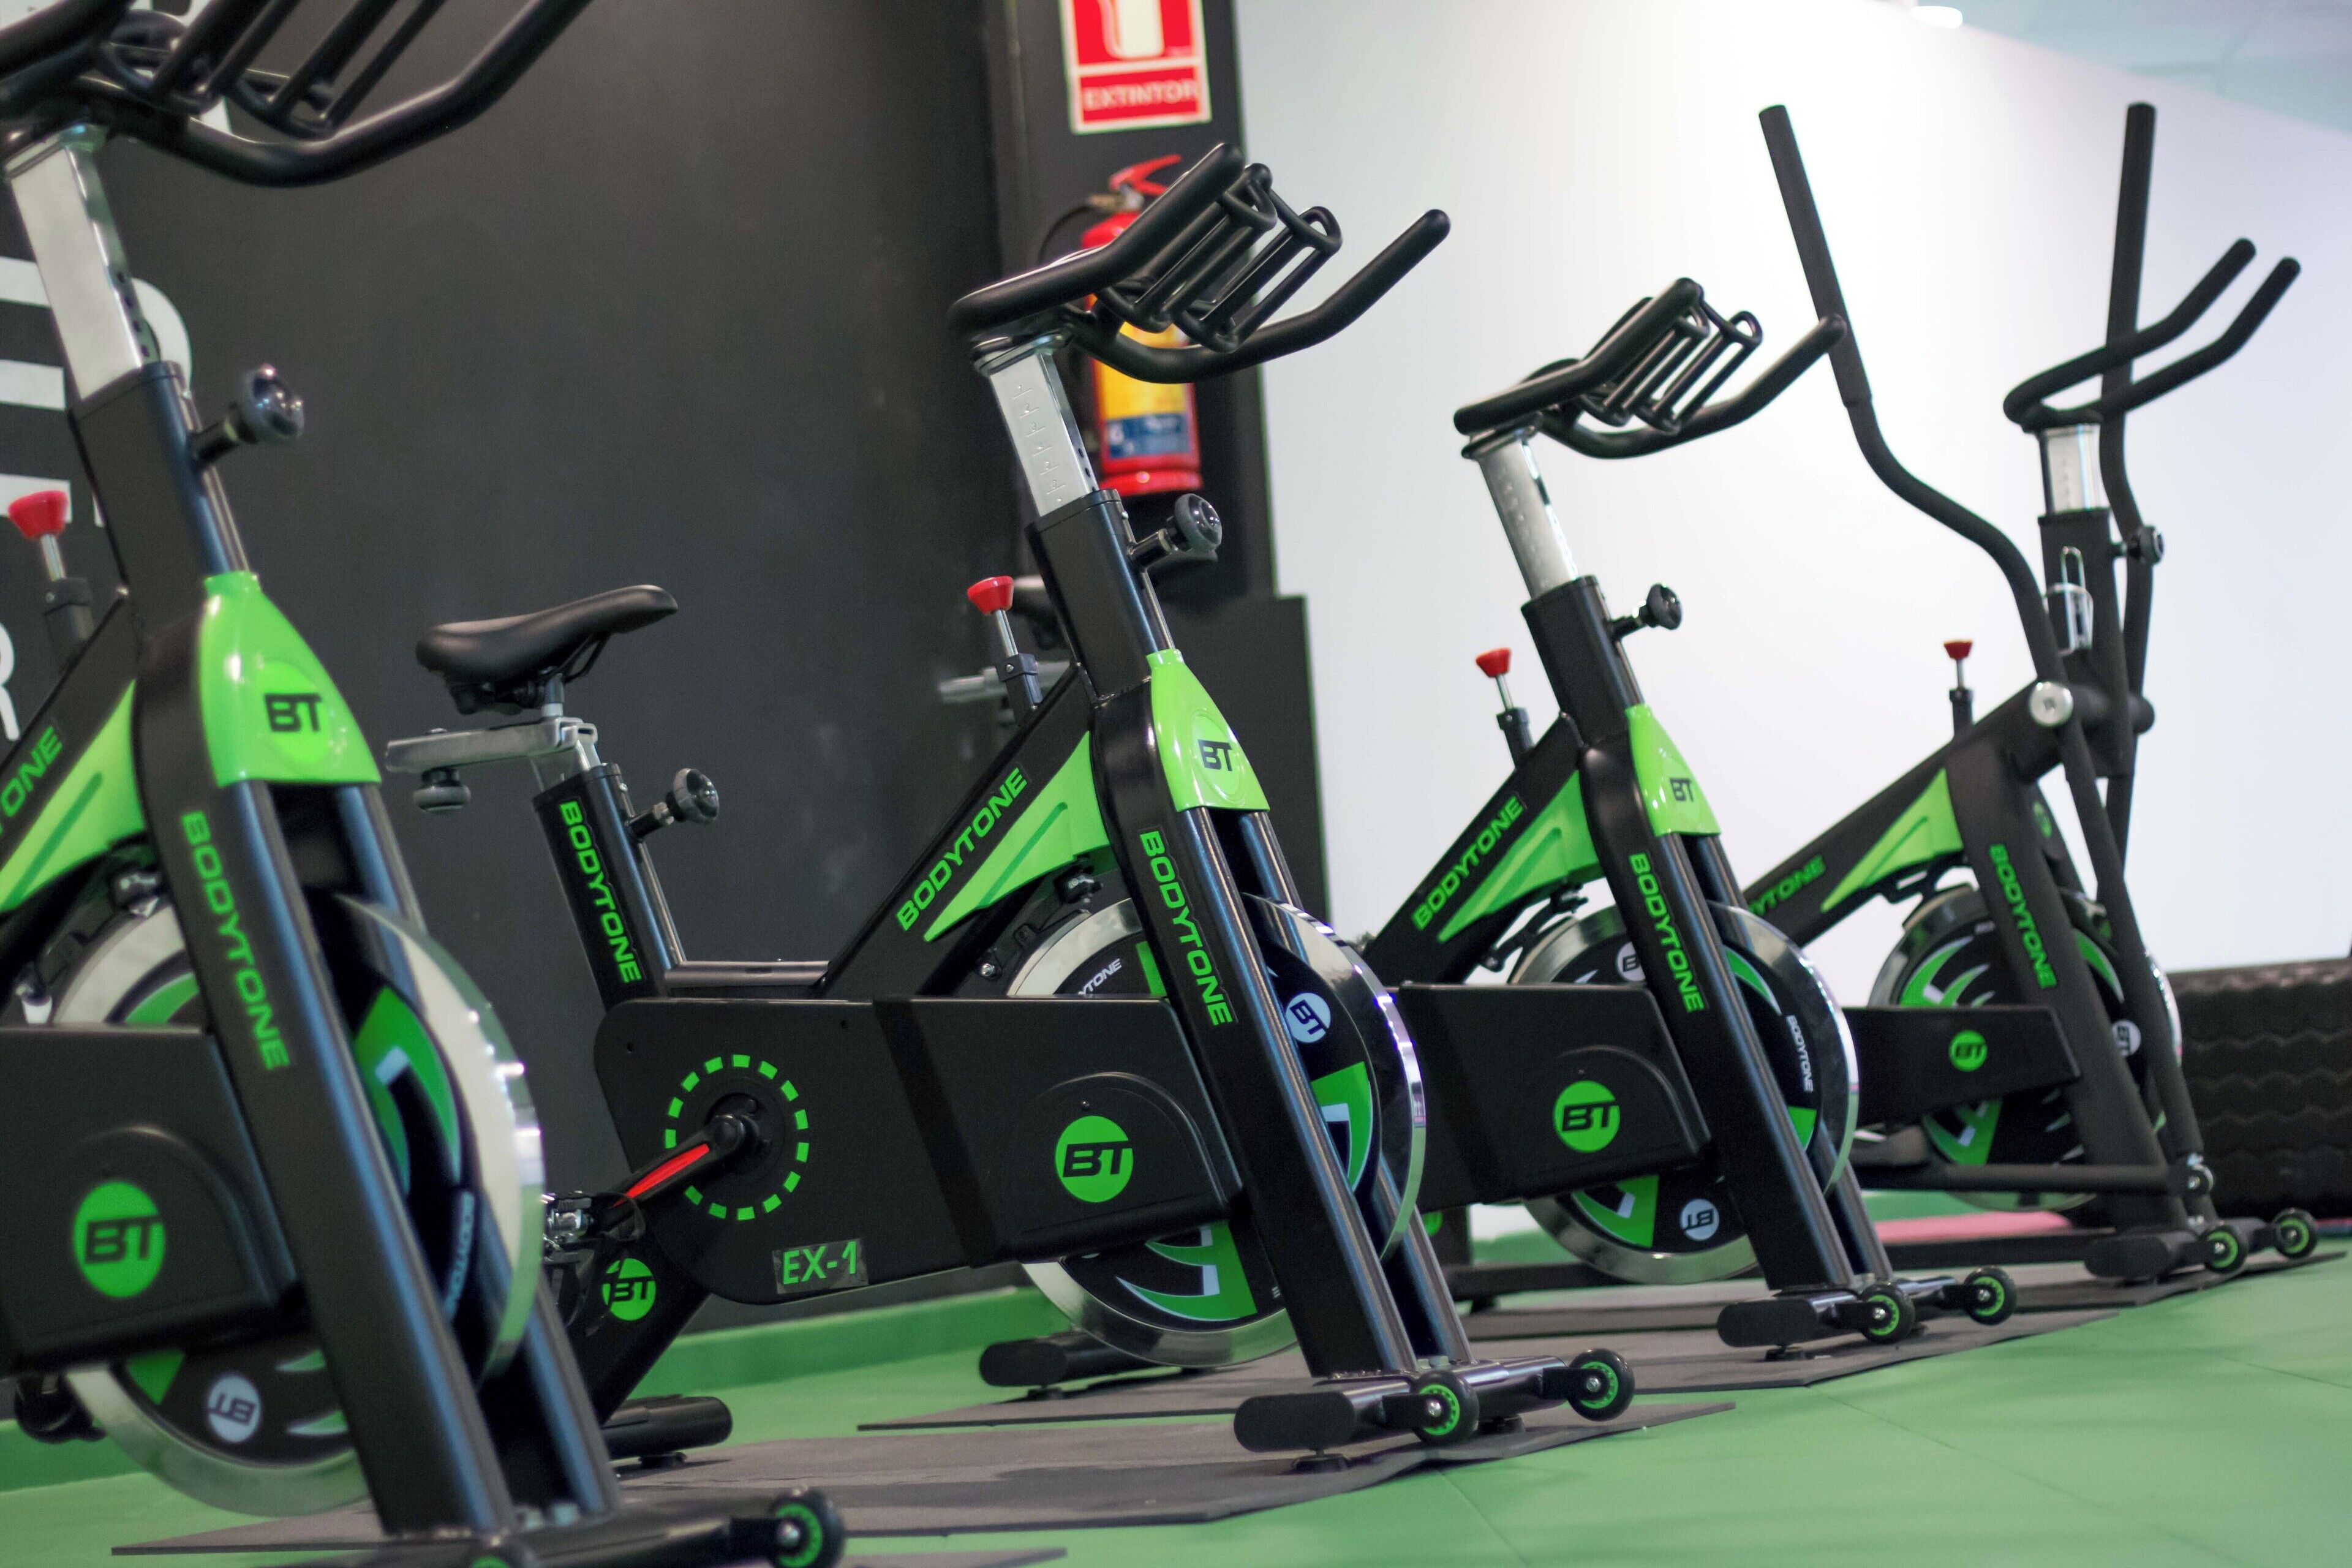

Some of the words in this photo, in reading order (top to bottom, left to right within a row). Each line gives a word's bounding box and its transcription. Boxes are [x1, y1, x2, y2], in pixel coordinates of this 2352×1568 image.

[1084, 78, 1196, 111] EXTINTOR
[265, 693, 322, 733] BT
[1197, 739, 1233, 771] BT
[0, 726, 62, 835] ONE
[1670, 777, 1694, 802] BT
[896, 767, 1027, 931] BODYTONE
[1412, 796, 1523, 930] BODYTONE
[560, 801, 642, 982] BODYTONE
[1748, 856, 1825, 915] YTONE
[1139, 831, 1232, 1025] BODYTONE
[1629, 853, 1705, 1012] BODYTONE
[1989, 845, 2056, 989] BODYTONE
[180, 810, 290, 1070] BODYTONE
[1078, 959, 1122, 995] YTONE
[1290, 999, 1327, 1035] BT
[1787, 1015, 1813, 1091] BODYTONE
[1955, 1042, 1985, 1058] BT
[1562, 1101, 1618, 1133] BT
[1063, 1141, 1131, 1177] BT
[85, 1216, 160, 1264] BT
[1684, 1209, 1714, 1231] BT
[783, 1240, 858, 1284] EX-1
[610, 1276, 654, 1302] BT
[209, 1393, 255, 1426] BT
